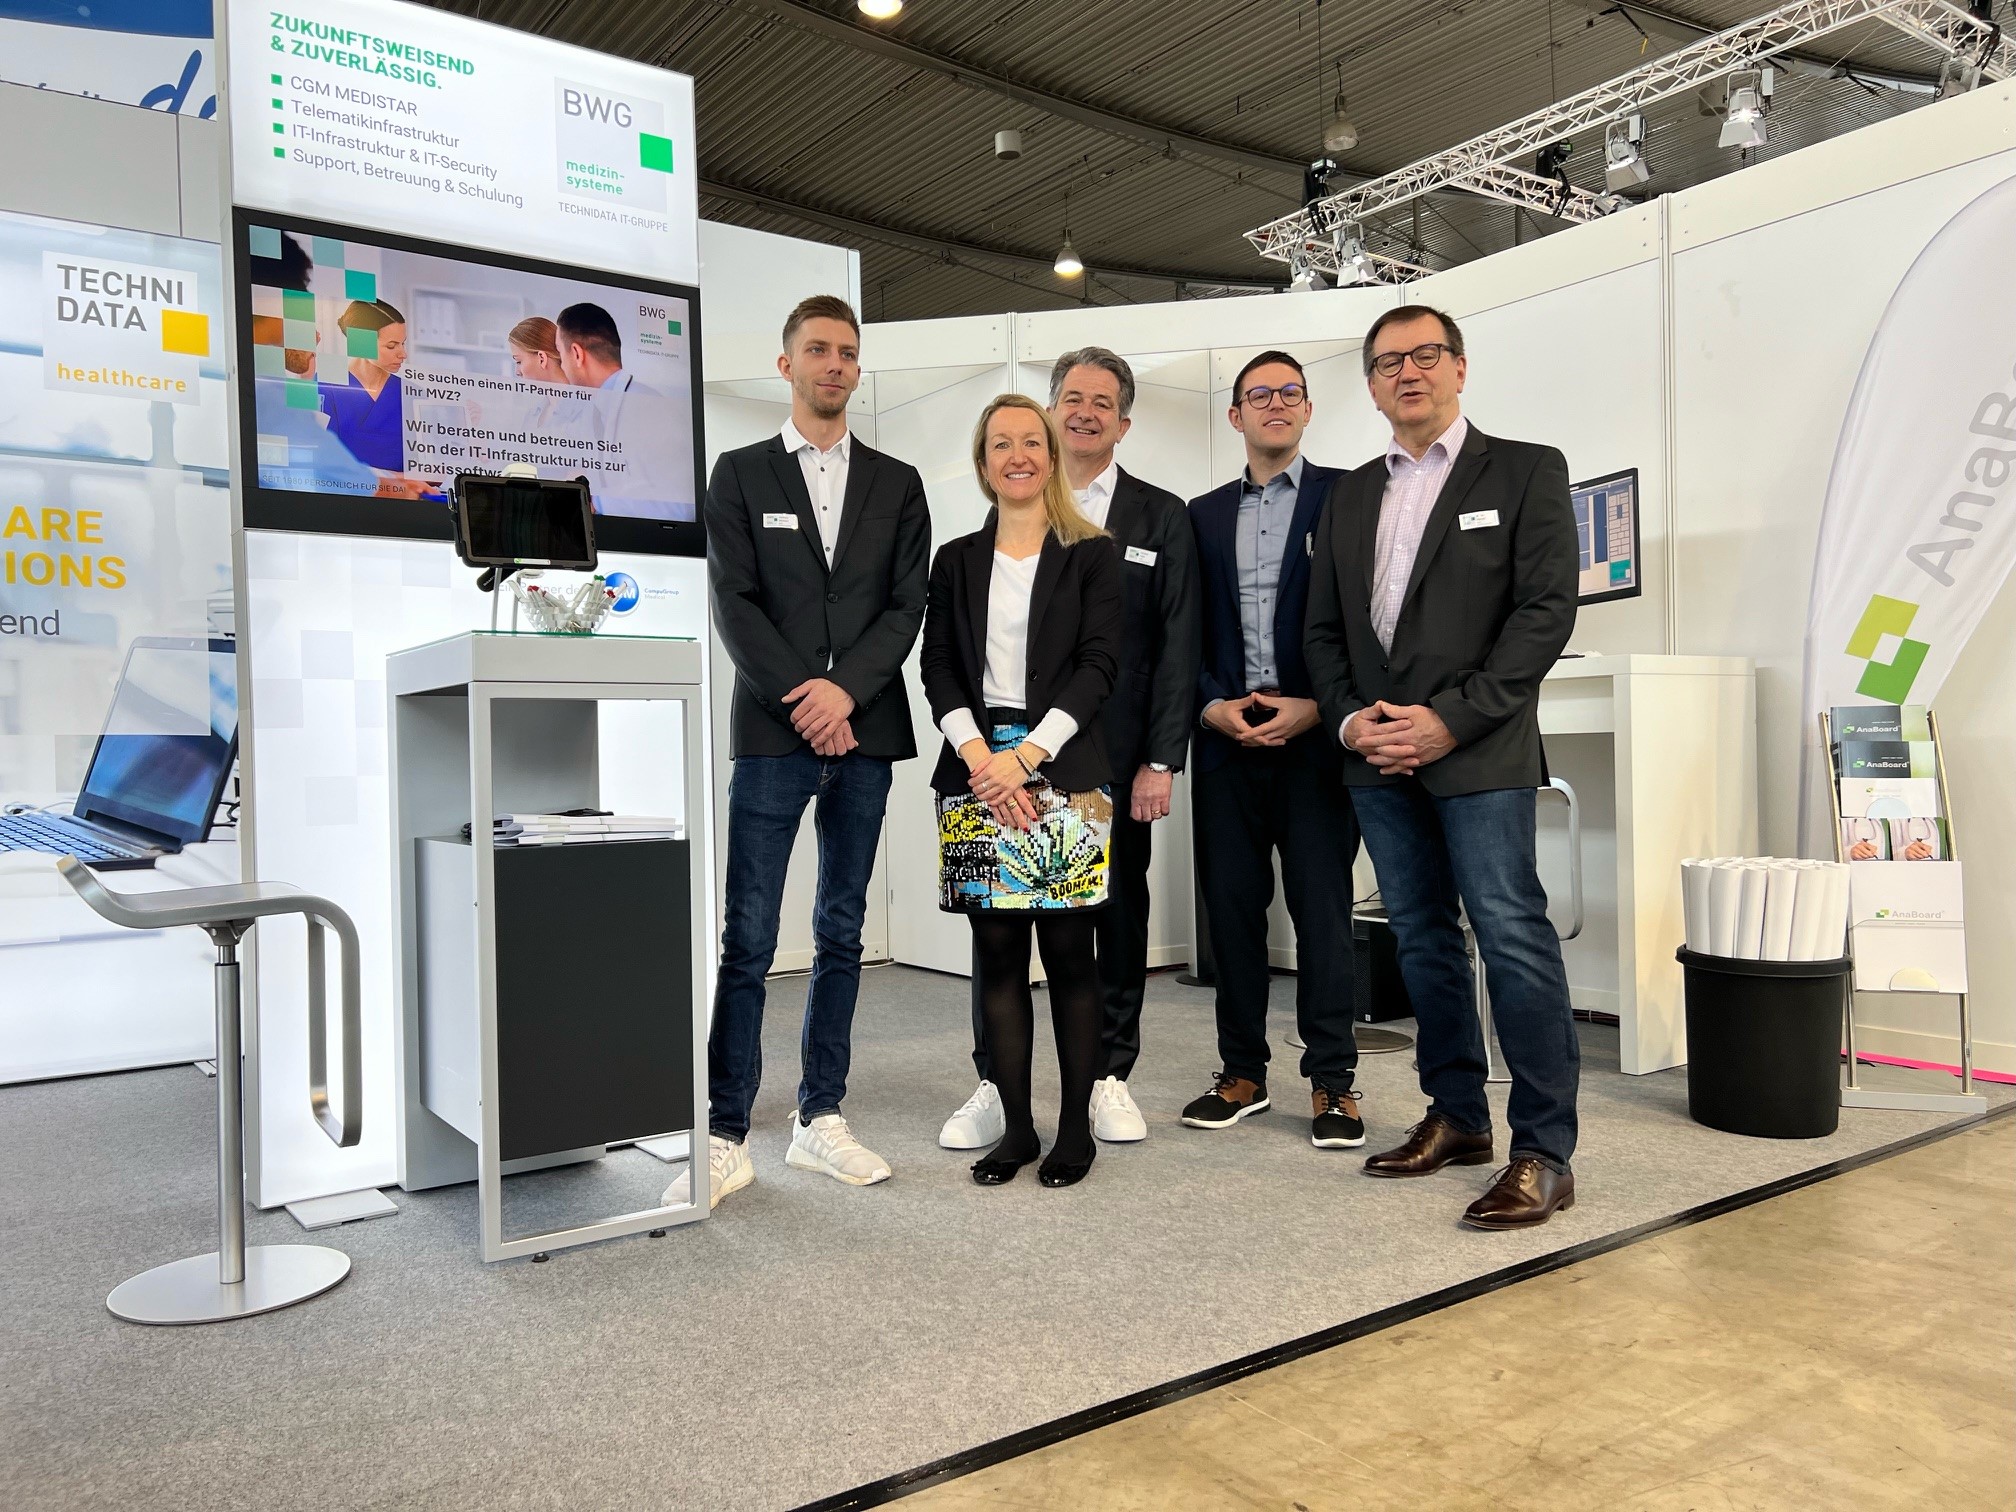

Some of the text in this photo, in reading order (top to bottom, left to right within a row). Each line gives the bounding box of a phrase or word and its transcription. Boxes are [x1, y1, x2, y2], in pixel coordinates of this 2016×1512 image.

[270, 12, 475, 75] ZUKUNFTSWEISEND
[271, 35, 442, 90] & ZUVERLÄSSIG.
[291, 76, 418, 116] CGM MEDISTAR
[564, 88, 632, 128] BWG
[291, 99, 459, 148] Telematikinfrastruktur
[293, 124, 497, 182] IT-Infrastruktur & IT-Security
[566, 160, 625, 180] medizin-
[293, 149, 523, 208] Support, Betreuung & Schulung
[567, 175, 623, 195] systeme
[558, 202, 668, 232] TECHNIDATA IT-GRUPPE
[57, 264, 184, 306] TECHNI
[57, 296, 147, 332] DATA
[639, 305, 666, 320] BWG
[58, 362, 187, 394] healthcare
[404, 368, 592, 401] Sie suchen einen IT-Partner für
[405, 386, 461, 400] Ihr MVZ?
[406, 419, 622, 453] Wir beraten und betreuen Sie!
[406, 440, 626, 472] Von der IT-Infrastruktur bis zur
[262, 475, 280, 483] SEIT
[379, 484, 391, 492] SIE
[2, 505, 104, 544] ARE
[5, 551, 127, 590] IONS
[0, 609, 60, 636] end
